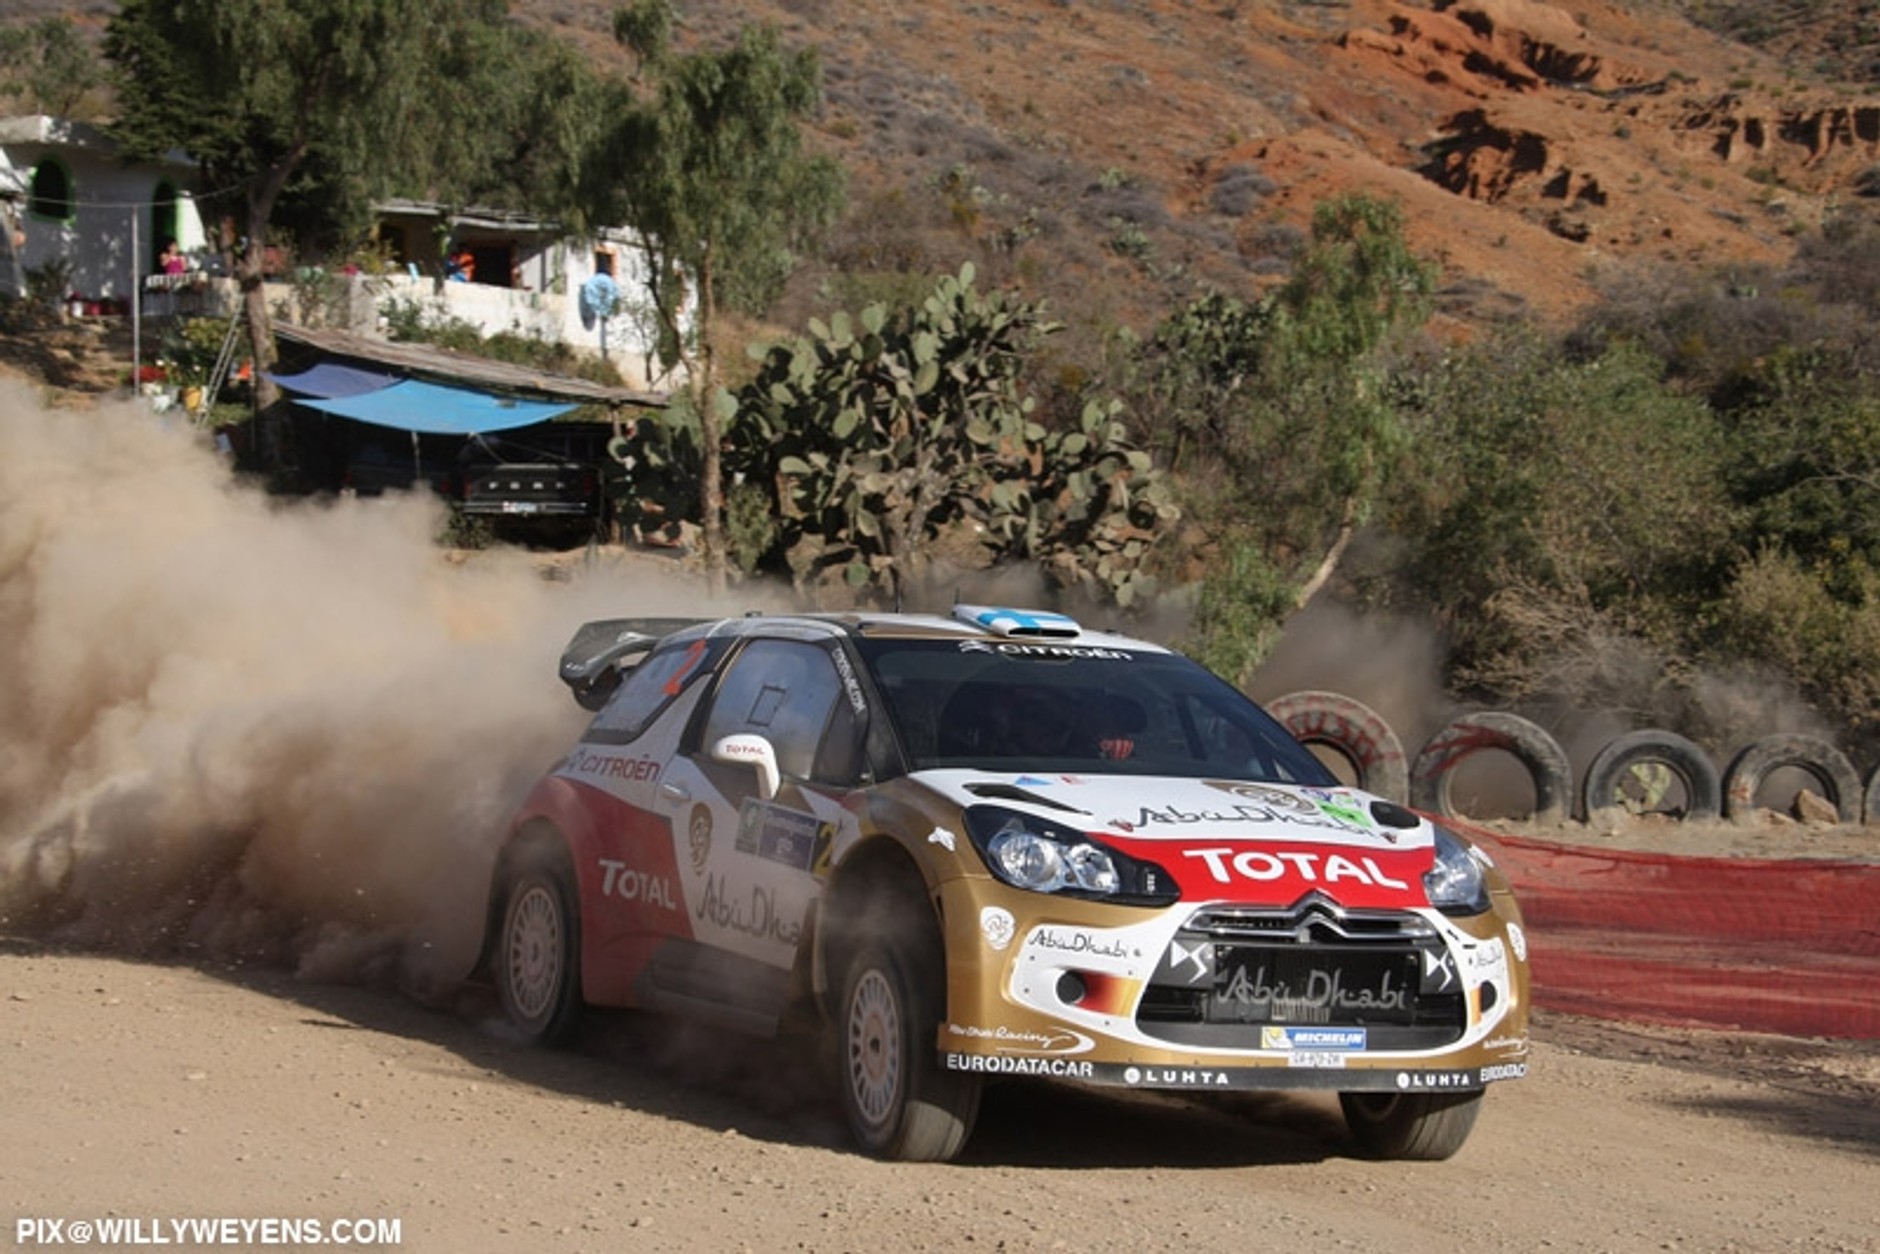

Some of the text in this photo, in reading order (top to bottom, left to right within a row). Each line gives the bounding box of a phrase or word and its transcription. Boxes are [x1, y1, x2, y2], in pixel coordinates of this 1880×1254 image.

[725, 744, 765, 756] TOTAL
[814, 822, 836, 877] 2
[1182, 848, 1408, 891] TOTAL
[598, 858, 677, 912] TOTAL
[1292, 1031, 1364, 1044] MICHELIN
[946, 1053, 1093, 1078] EURODATACAR
[1146, 1069, 1229, 1085] LUHTA
[1413, 1073, 1470, 1088] LUHTA
